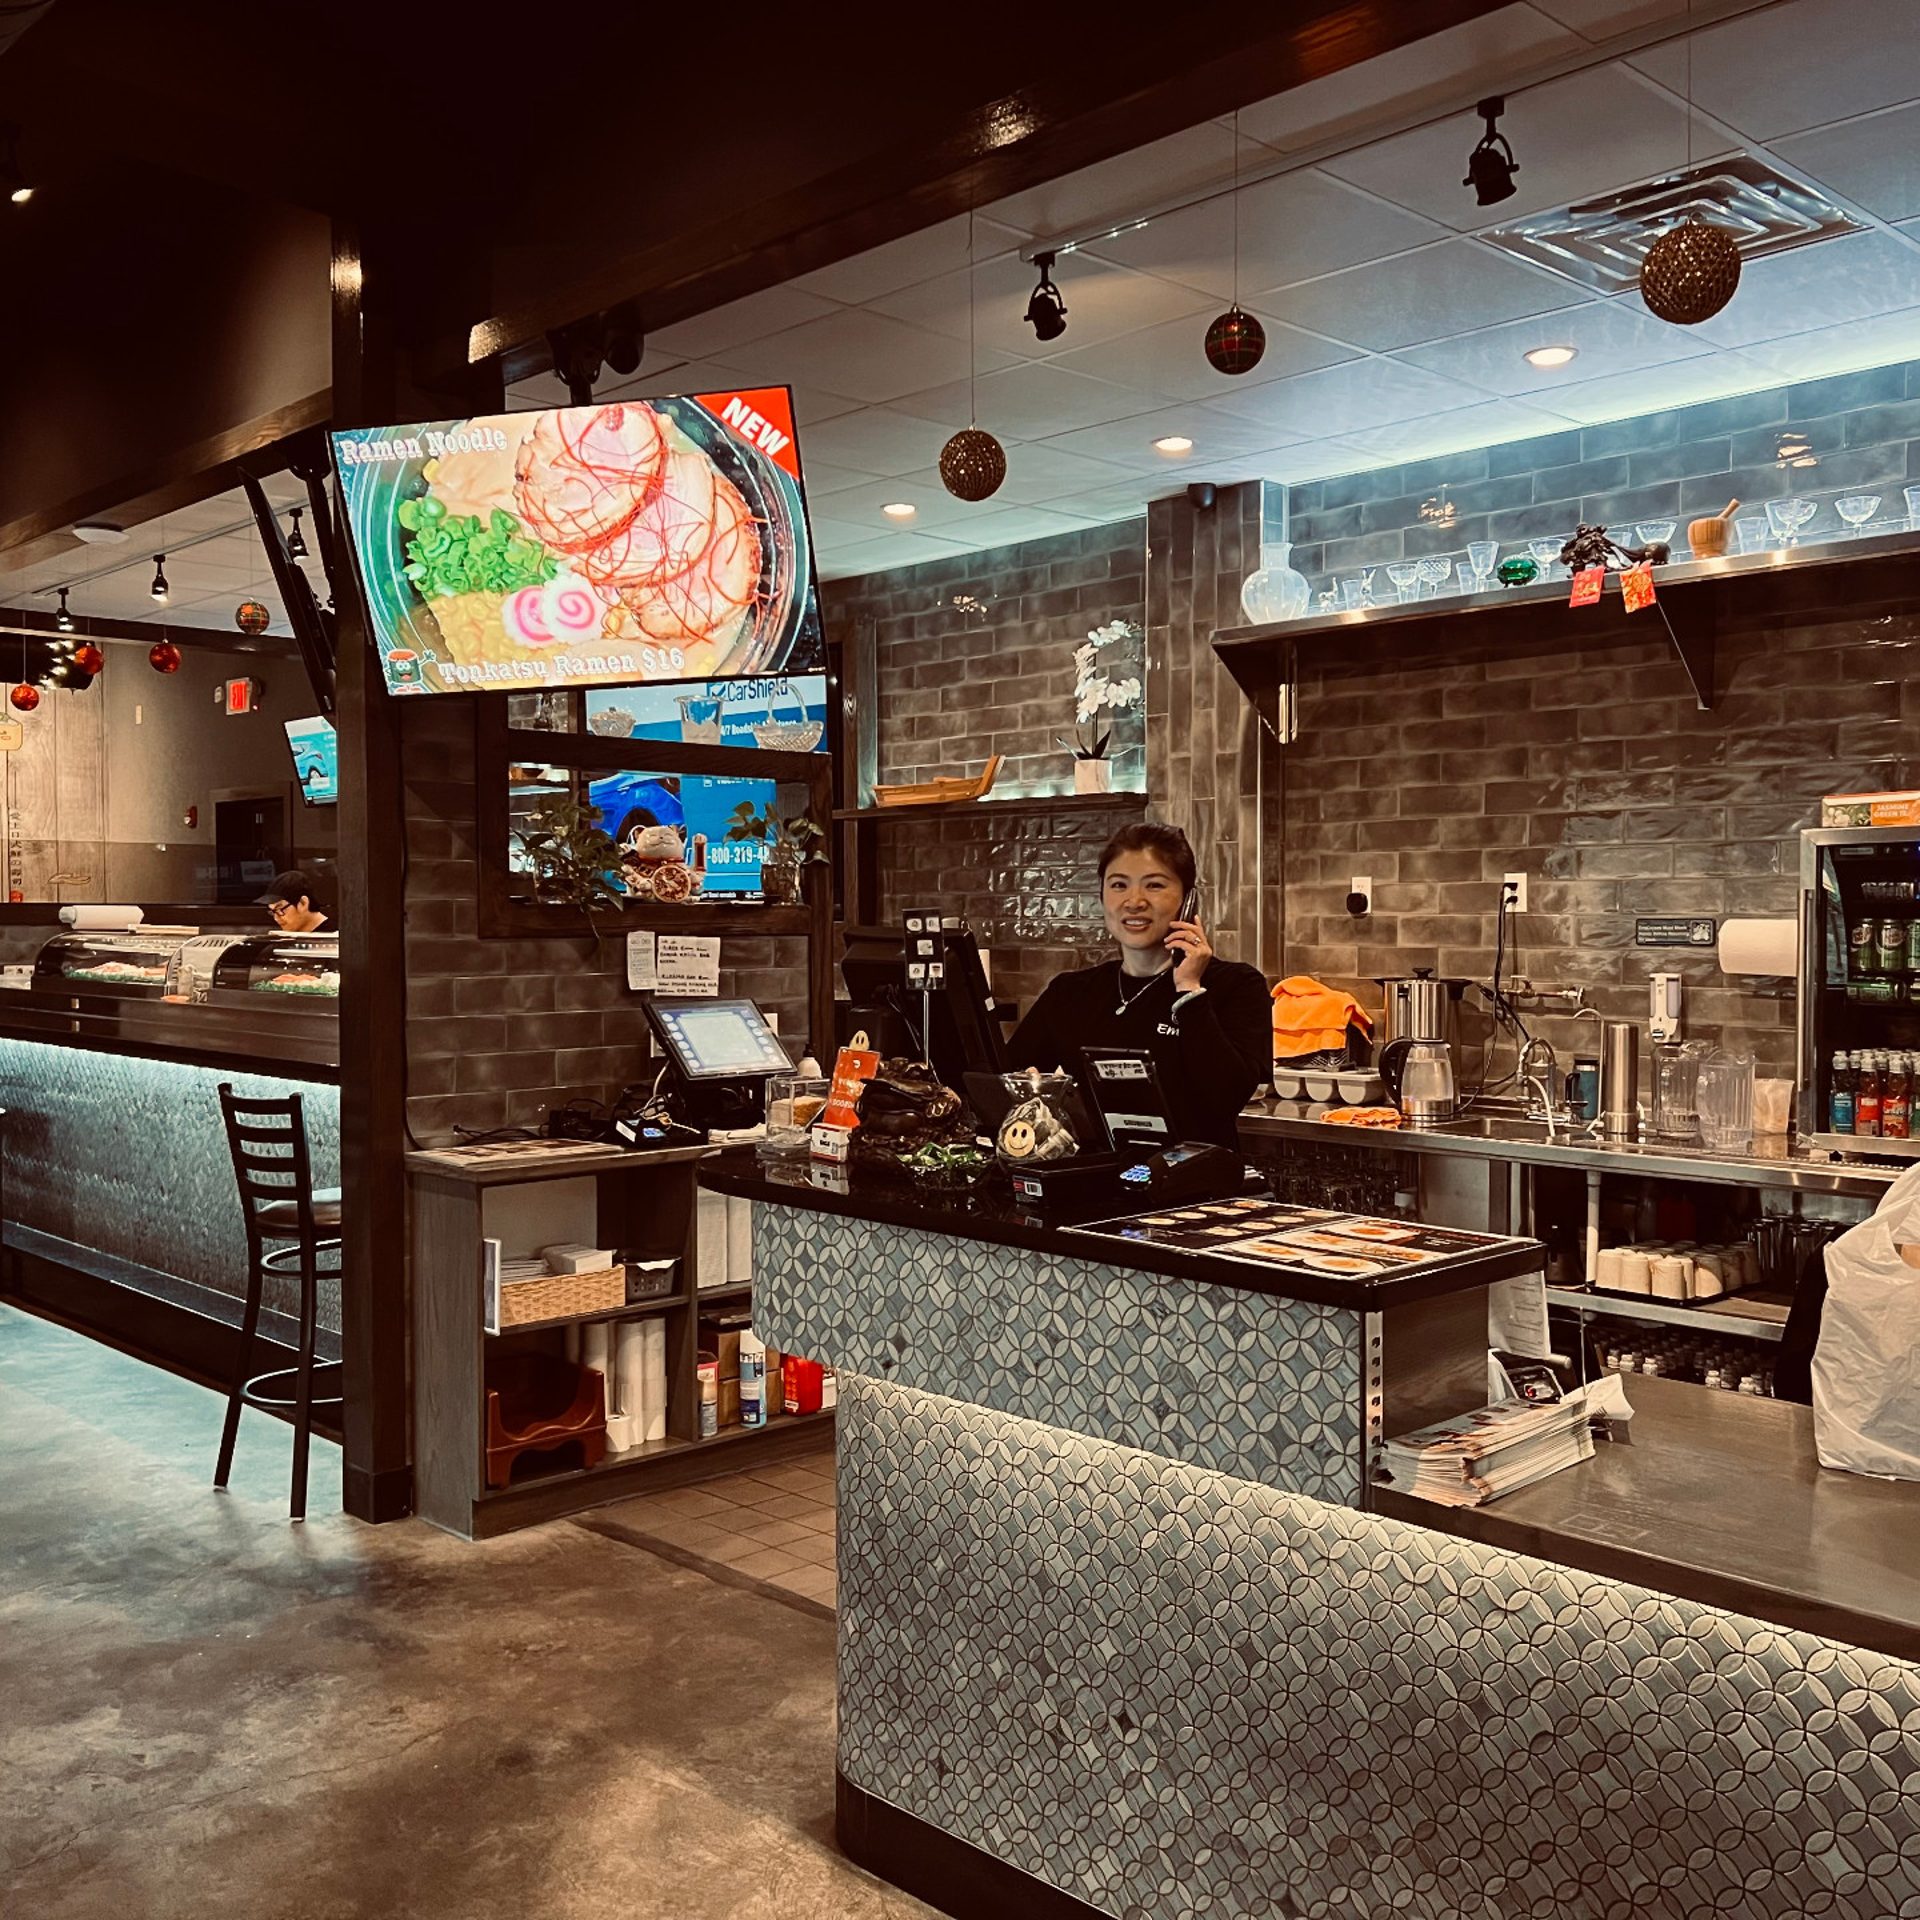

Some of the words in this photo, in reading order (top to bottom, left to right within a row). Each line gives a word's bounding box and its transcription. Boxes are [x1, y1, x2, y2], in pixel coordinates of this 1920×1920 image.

[339, 437, 422, 465] Ramen
[428, 426, 508, 457] Noodle
[720, 396, 792, 456] NEW
[437, 656, 548, 686] Tonkatsu
[554, 652, 637, 679] Ramen
[642, 647, 685, 673] $16
[727, 677, 788, 702] CarShield
[1876, 803, 1909, 811] JASMINE
